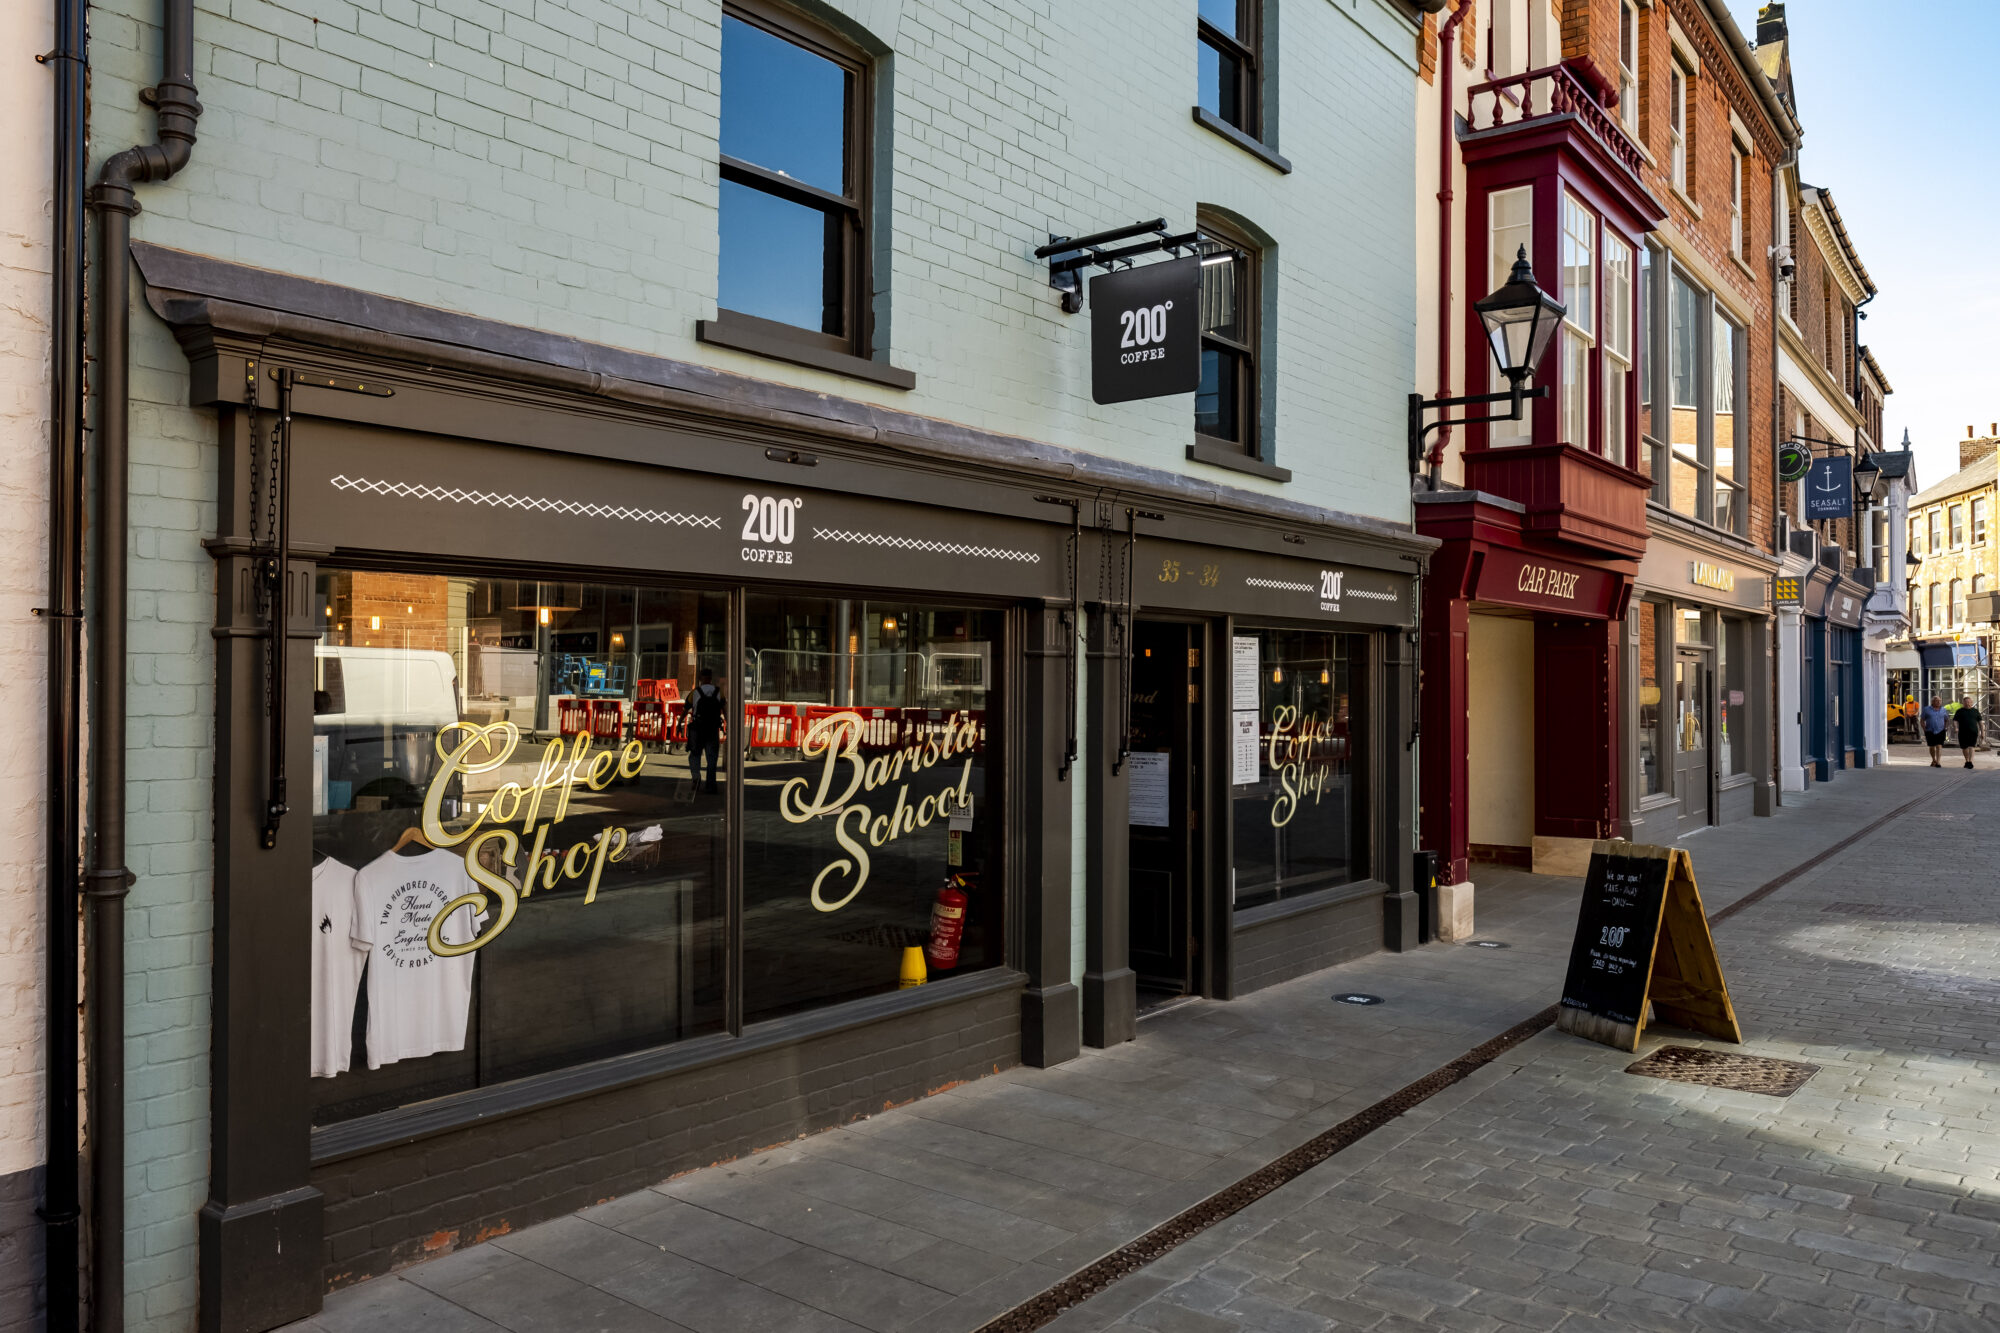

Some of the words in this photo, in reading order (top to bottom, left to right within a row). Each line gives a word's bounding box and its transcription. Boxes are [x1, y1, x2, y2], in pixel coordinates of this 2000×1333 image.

[1120, 300, 1174, 349] 200°
[1120, 347, 1165, 365] COFFEE
[741, 493, 803, 545] 200°
[1810, 497, 1846, 508] SEASALT
[741, 547, 793, 565] COFFEE
[1158, 559, 1181, 583] 35
[1199, 564, 1219, 588] 34
[1320, 569, 1344, 600] 200°
[1518, 564, 1546, 594] CAR
[1545, 569, 1580, 599] PARK
[1320, 601, 1340, 612] COFFEE
[1269, 705, 1334, 770] Coffee
[421, 721, 647, 848] Coffee
[780, 711, 978, 824] Barista
[1271, 761, 1329, 827] Shop
[811, 758, 973, 913] School
[380, 903, 393, 925] TWO
[391, 879, 428, 902] HUNDRED
[400, 895, 433, 911] Hand
[427, 823, 629, 957] Shop
[400, 911, 432, 927] Made
[394, 929, 428, 946] Engla
